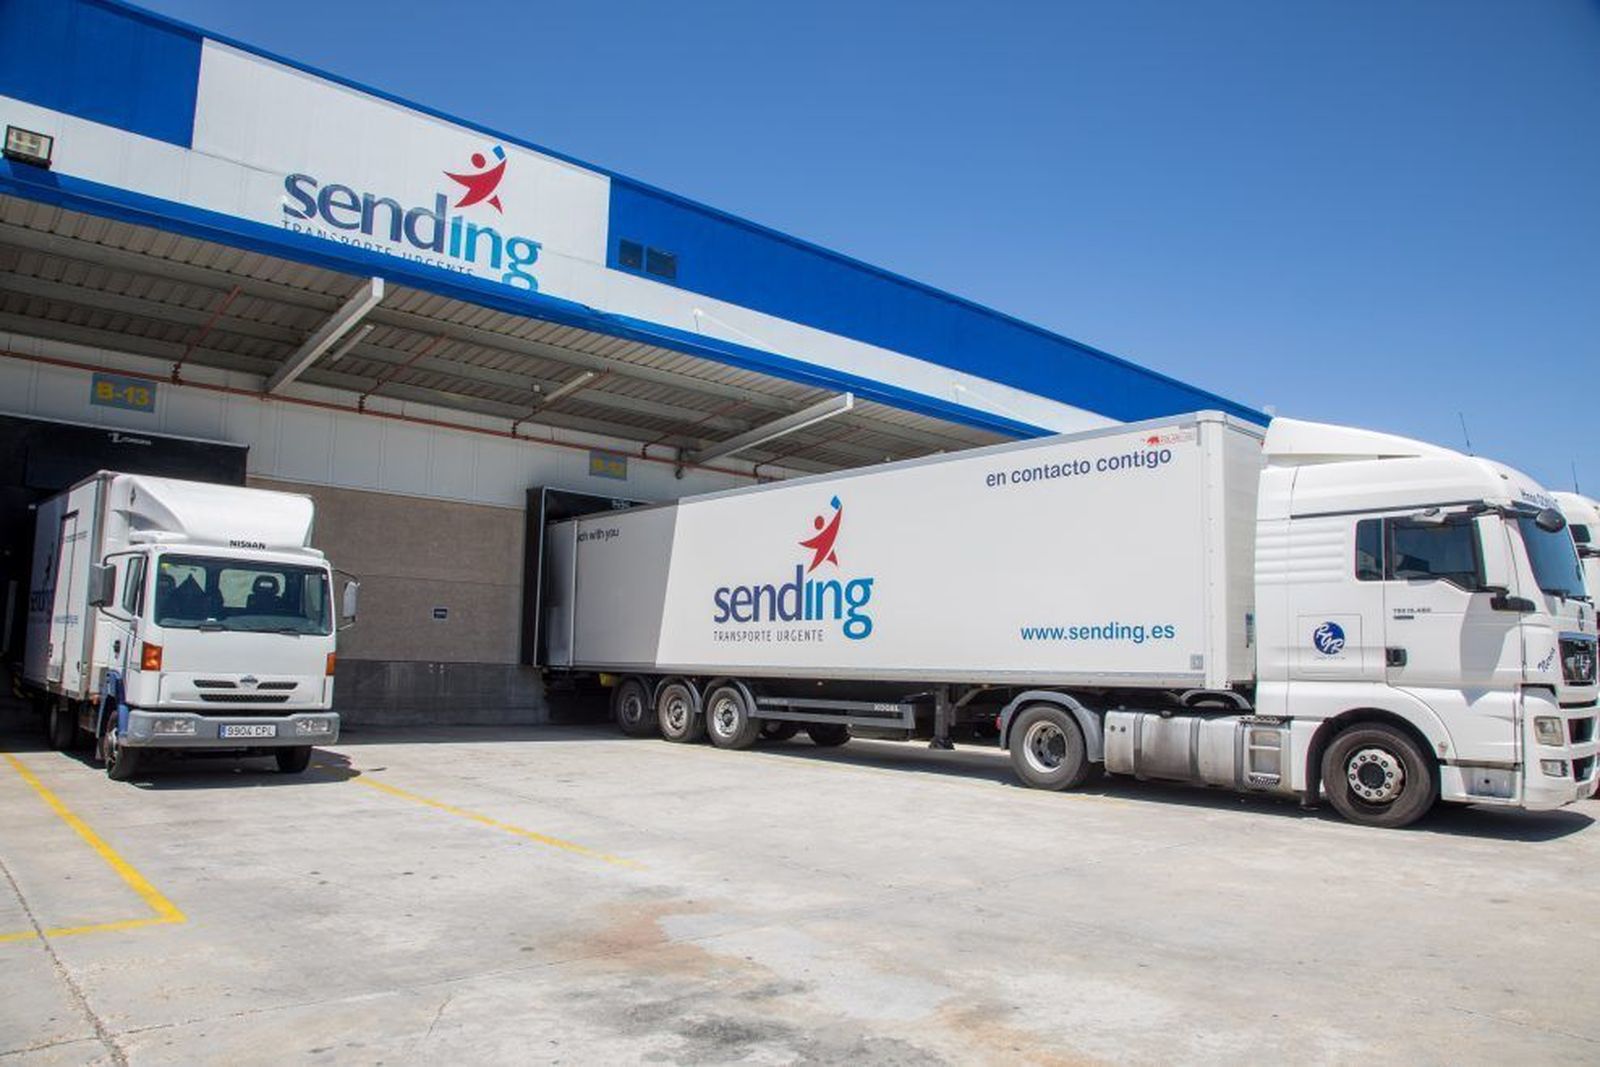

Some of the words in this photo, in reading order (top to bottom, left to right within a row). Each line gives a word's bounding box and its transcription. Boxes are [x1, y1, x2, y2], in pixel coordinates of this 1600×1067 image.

[283, 173, 542, 291] sending
[986, 472, 1006, 487] en
[1011, 459, 1091, 483] contacto
[1096, 449, 1172, 472] contigo
[605, 528, 620, 542] you
[229, 540, 266, 550] NISSAN
[714, 564, 875, 640] sending
[713, 630, 771, 642] TRANSPORTE
[776, 629, 824, 642] URGENTE
[1021, 621, 1175, 644] www.sending.es
[228, 726, 252, 736] 9904
